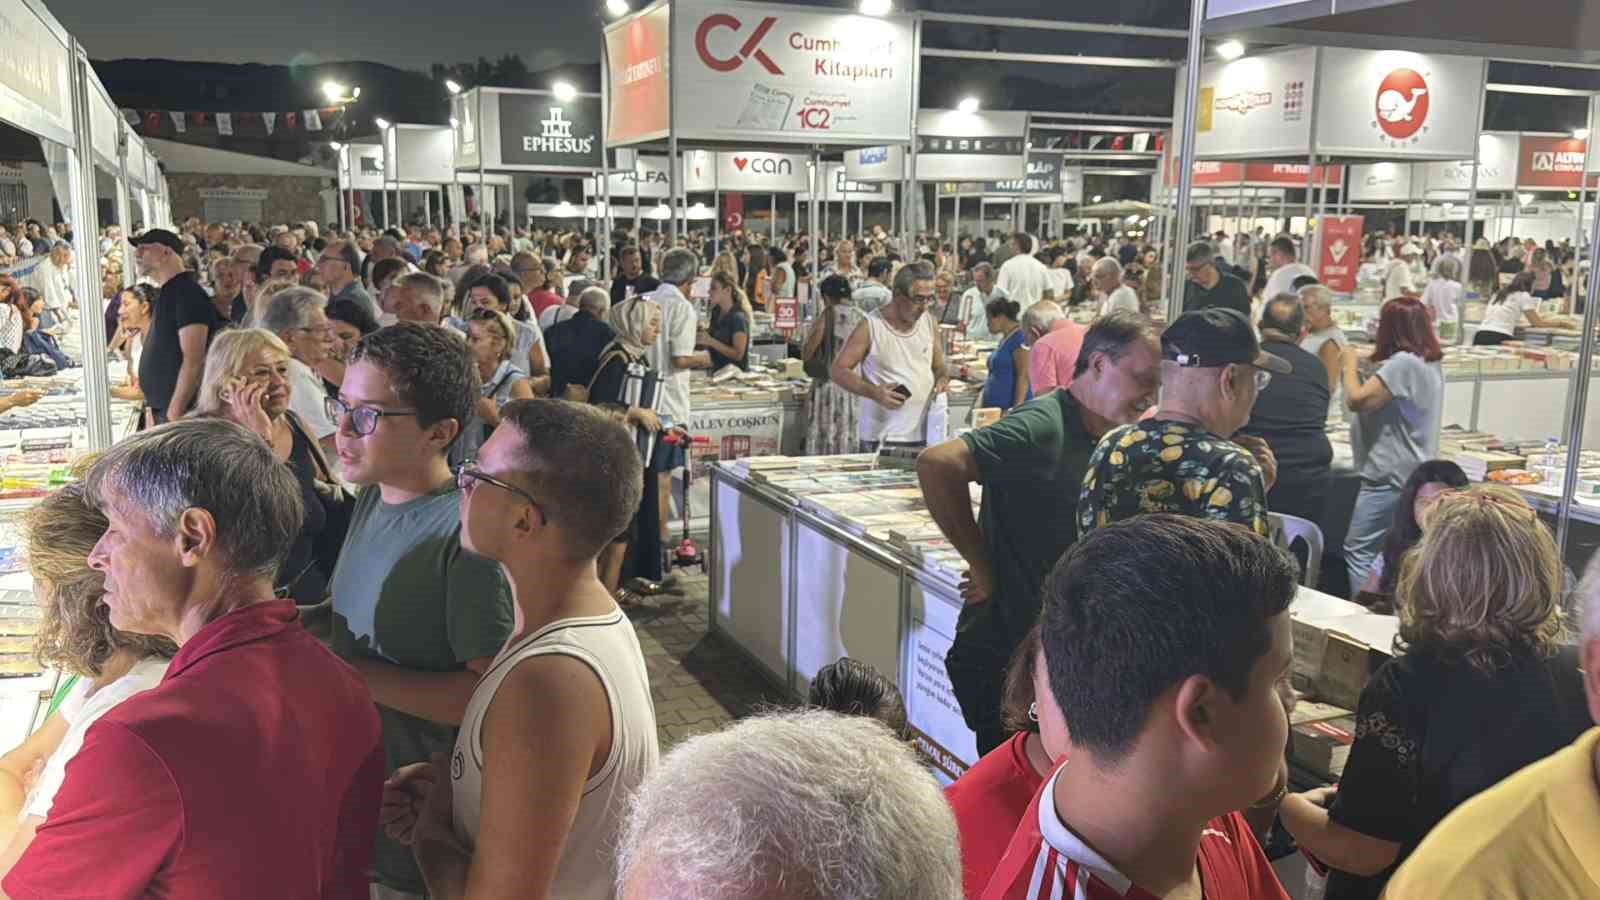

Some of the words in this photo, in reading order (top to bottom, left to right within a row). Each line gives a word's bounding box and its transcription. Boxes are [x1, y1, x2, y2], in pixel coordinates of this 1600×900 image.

[523, 136, 592, 153] EPHESUS
[751, 158, 792, 175] can
[621, 171, 669, 184] ALFA
